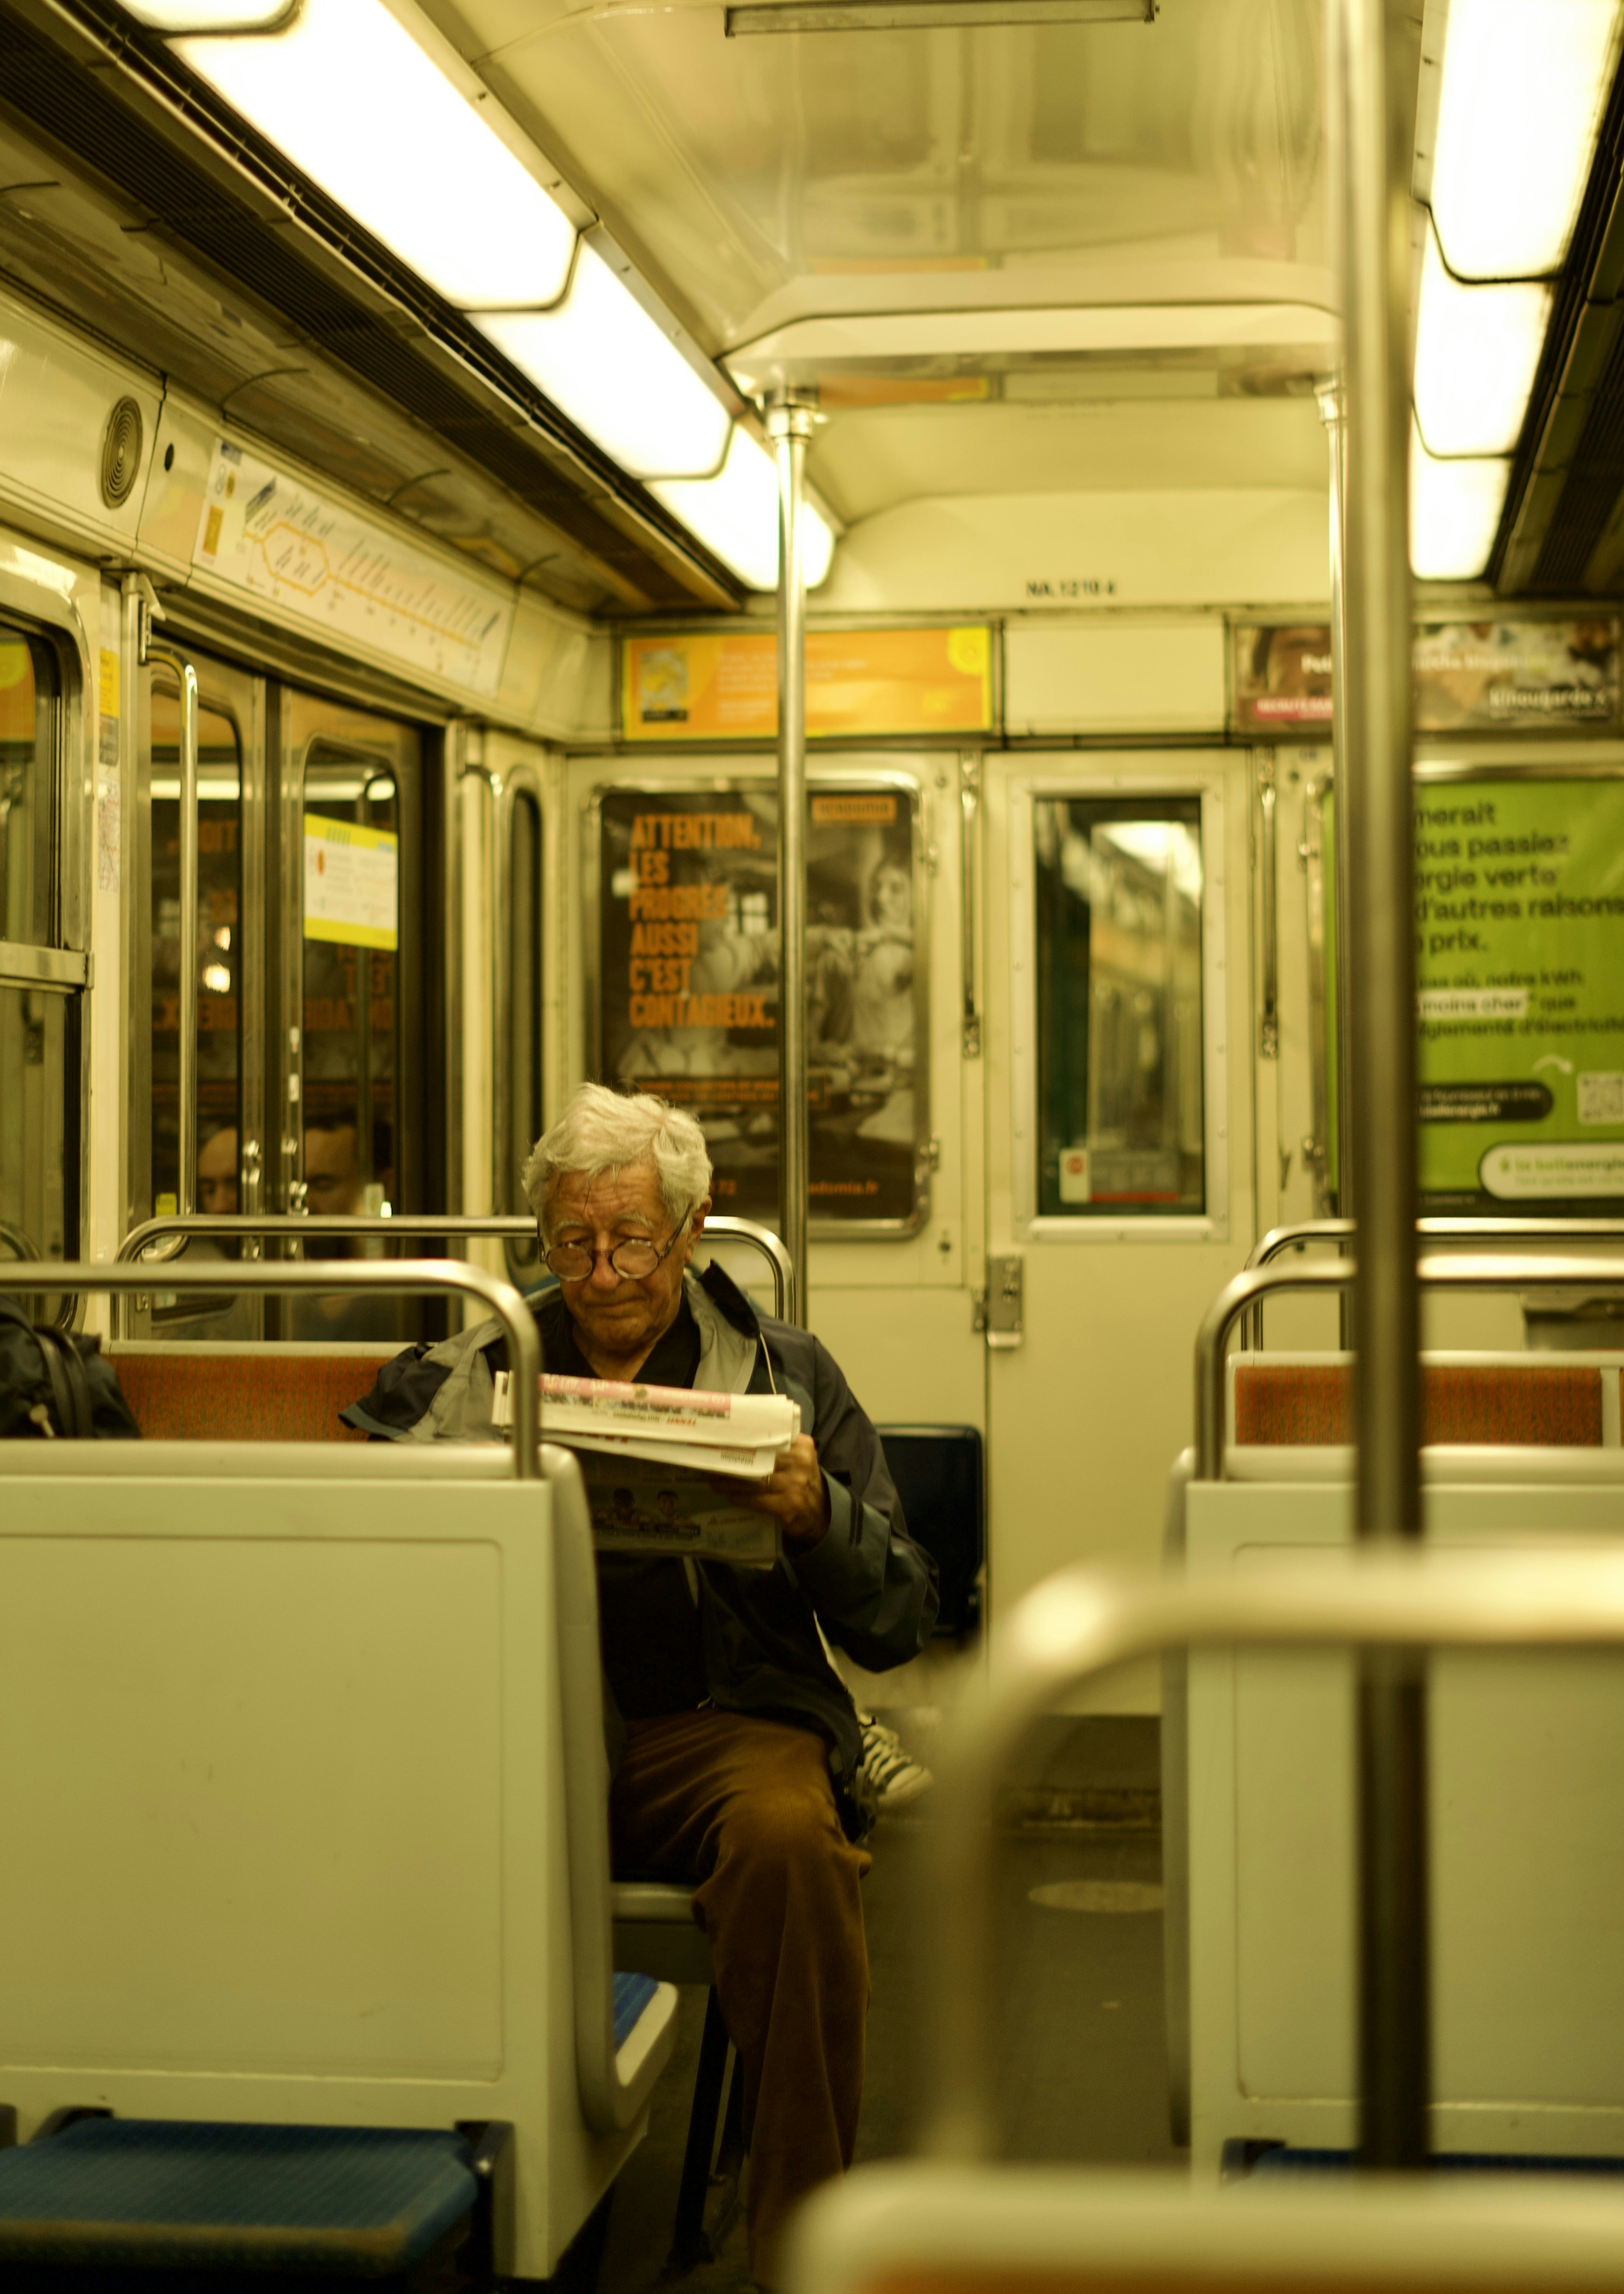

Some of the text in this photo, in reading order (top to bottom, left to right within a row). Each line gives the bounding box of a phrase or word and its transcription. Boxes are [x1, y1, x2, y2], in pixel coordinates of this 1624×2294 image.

[632, 814, 761, 850] ATTENTION,
[630, 851, 669, 883] LES
[1483, 864, 1556, 886] verte
[631, 923, 698, 956] AUSSI
[1430, 930, 1488, 955] prix.
[630, 959, 691, 993] C'EST
[630, 994, 775, 1028] CONTAGIEUX.
